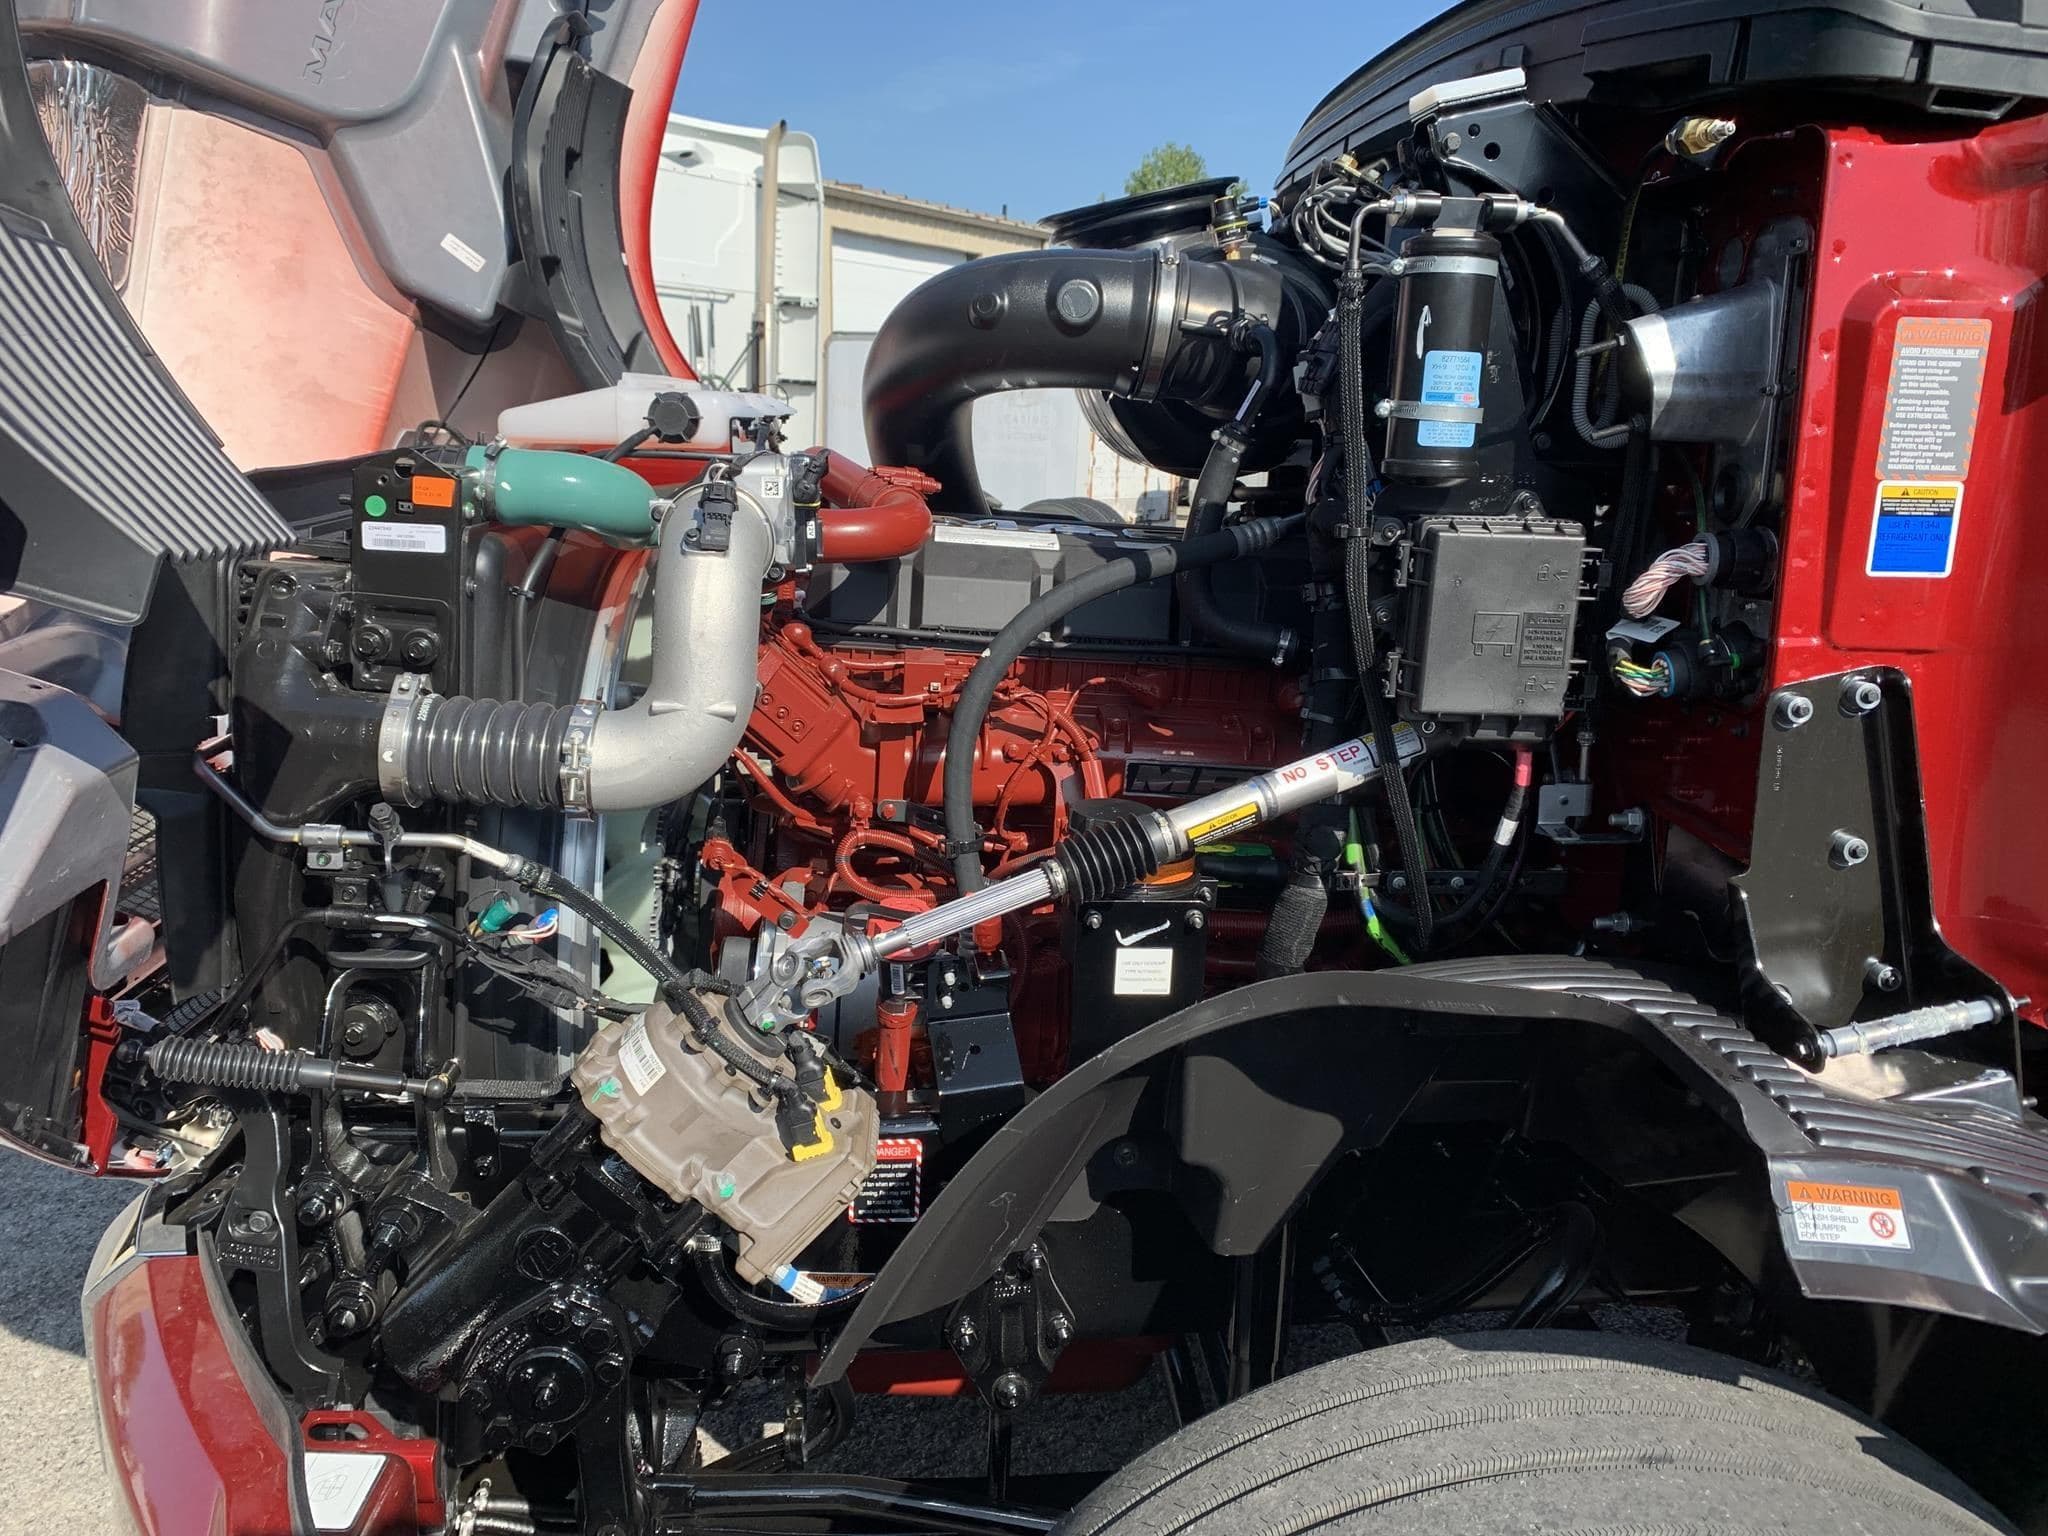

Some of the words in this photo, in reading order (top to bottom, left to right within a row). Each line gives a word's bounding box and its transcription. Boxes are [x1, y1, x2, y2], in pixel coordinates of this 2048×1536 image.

[1920, 328, 1981, 340] WARNING
[1901, 347, 1921, 355] AVOID
[1922, 348, 1954, 356] PERSONAL
[1956, 349, 1980, 357] INJURY
[1913, 488, 1939, 496] CAUTION
[1889, 520, 1902, 529] USE
[1879, 531, 1928, 542] REFRIGERANT
[1930, 532, 1949, 543] ONLY
[1282, 766, 1307, 784] NO
[1315, 745, 1360, 770] STEP
[1216, 812, 1239, 825] CAUTION
[1816, 1186, 1891, 1206] WARNING
[1794, 1202, 1806, 1211] DO
[1809, 1203, 1826, 1212] NOT
[1828, 1205, 1845, 1214] USE
[1797, 1212, 1829, 1221] SPLASH
[1829, 1214, 1860, 1225] SHIELD
[1799, 1222, 1811, 1230] OR
[1801, 1231, 1819, 1240] FOR
[1819, 1232, 1841, 1241] STEP
